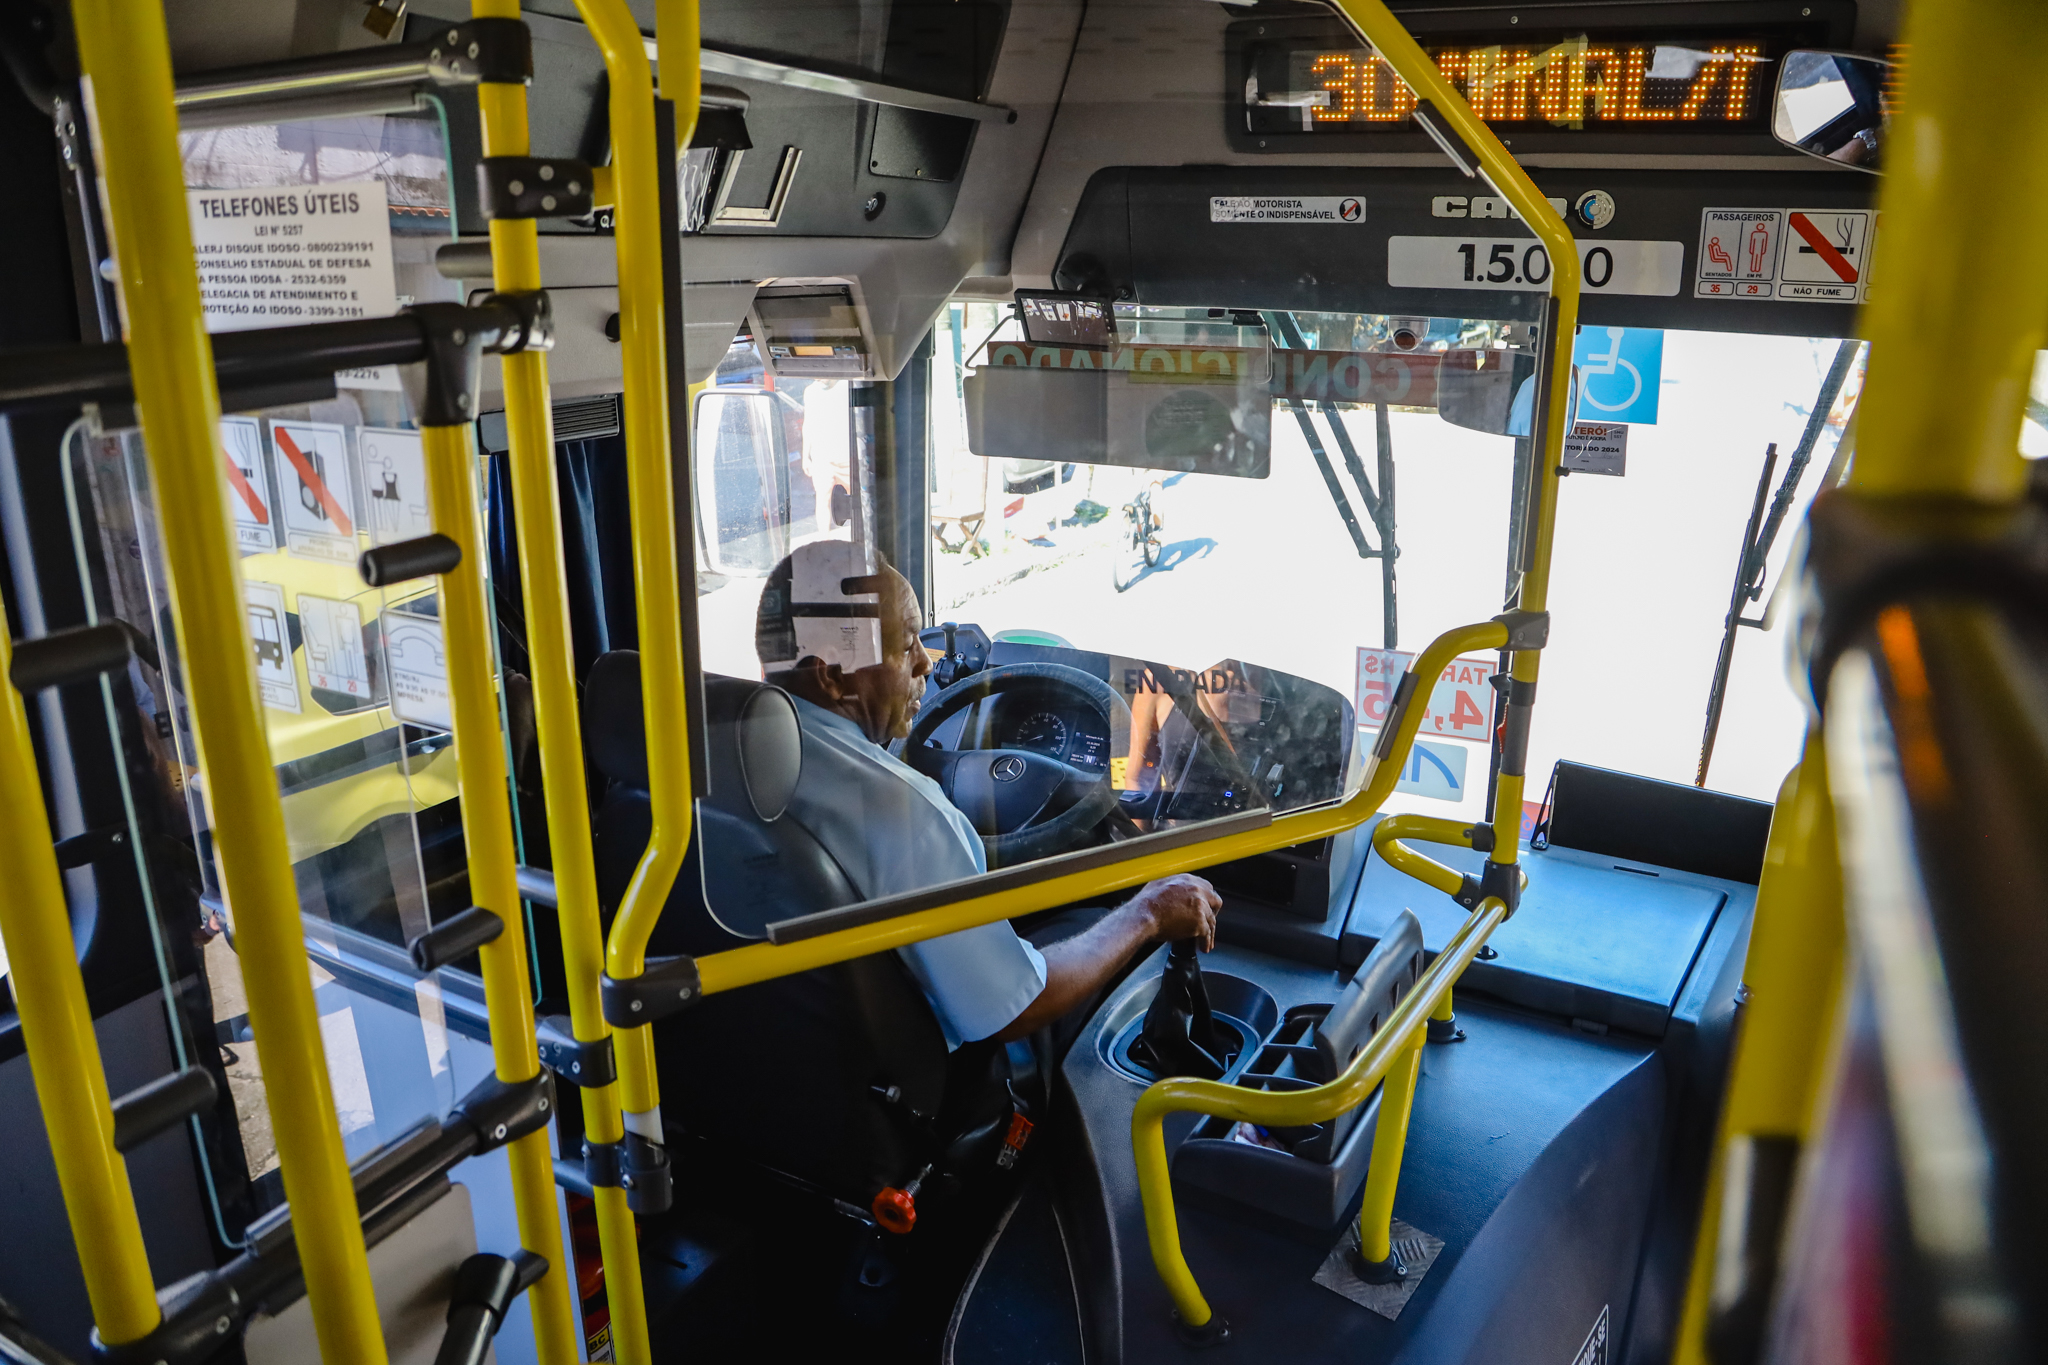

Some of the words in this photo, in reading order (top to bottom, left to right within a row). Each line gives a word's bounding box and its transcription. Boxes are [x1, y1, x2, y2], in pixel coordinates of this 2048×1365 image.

[200, 195, 299, 219] TELEFONES
[304, 190, 360, 216] ÚTEIS
[1253, 200, 1303, 208] MOTORISTA
[1257, 210, 1265, 218] O
[1266, 209, 1336, 219] INDISPENSÁVEL
[1712, 213, 1774, 222] PASSAGEIROS
[254, 226, 269, 237] LEI
[282, 224, 303, 236] 5257
[226, 243, 263, 255] DISQUE
[267, 243, 301, 254] IDOSO
[307, 242, 374, 253] 0800239191
[250, 259, 306, 269] ESTADUAL
[309, 258, 322, 269] DE
[327, 258, 372, 268] DEFESA
[1457, 243, 1614, 288] 1.5.00
[208, 275, 247, 284] PESSOA
[250, 275, 282, 284] IDOSA
[291, 274, 346, 284] 2532-6359
[1709, 284, 1721, 293] 35
[1747, 285, 1758, 294] 29
[1793, 286, 1812, 296] NÃO
[1816, 288, 1841, 297] FUME
[201, 290, 250, 299] ELEGACIA
[253, 290, 267, 299] DE
[269, 290, 348, 300] ATENDIMENTO
[351, 291, 358, 300] E
[202, 304, 249, 316] ROTEÇÃO
[252, 306, 266, 314] AO
[269, 306, 302, 315] IDOSO
[308, 307, 363, 317] 3399-3181
[240, 529, 262, 543] FUME
